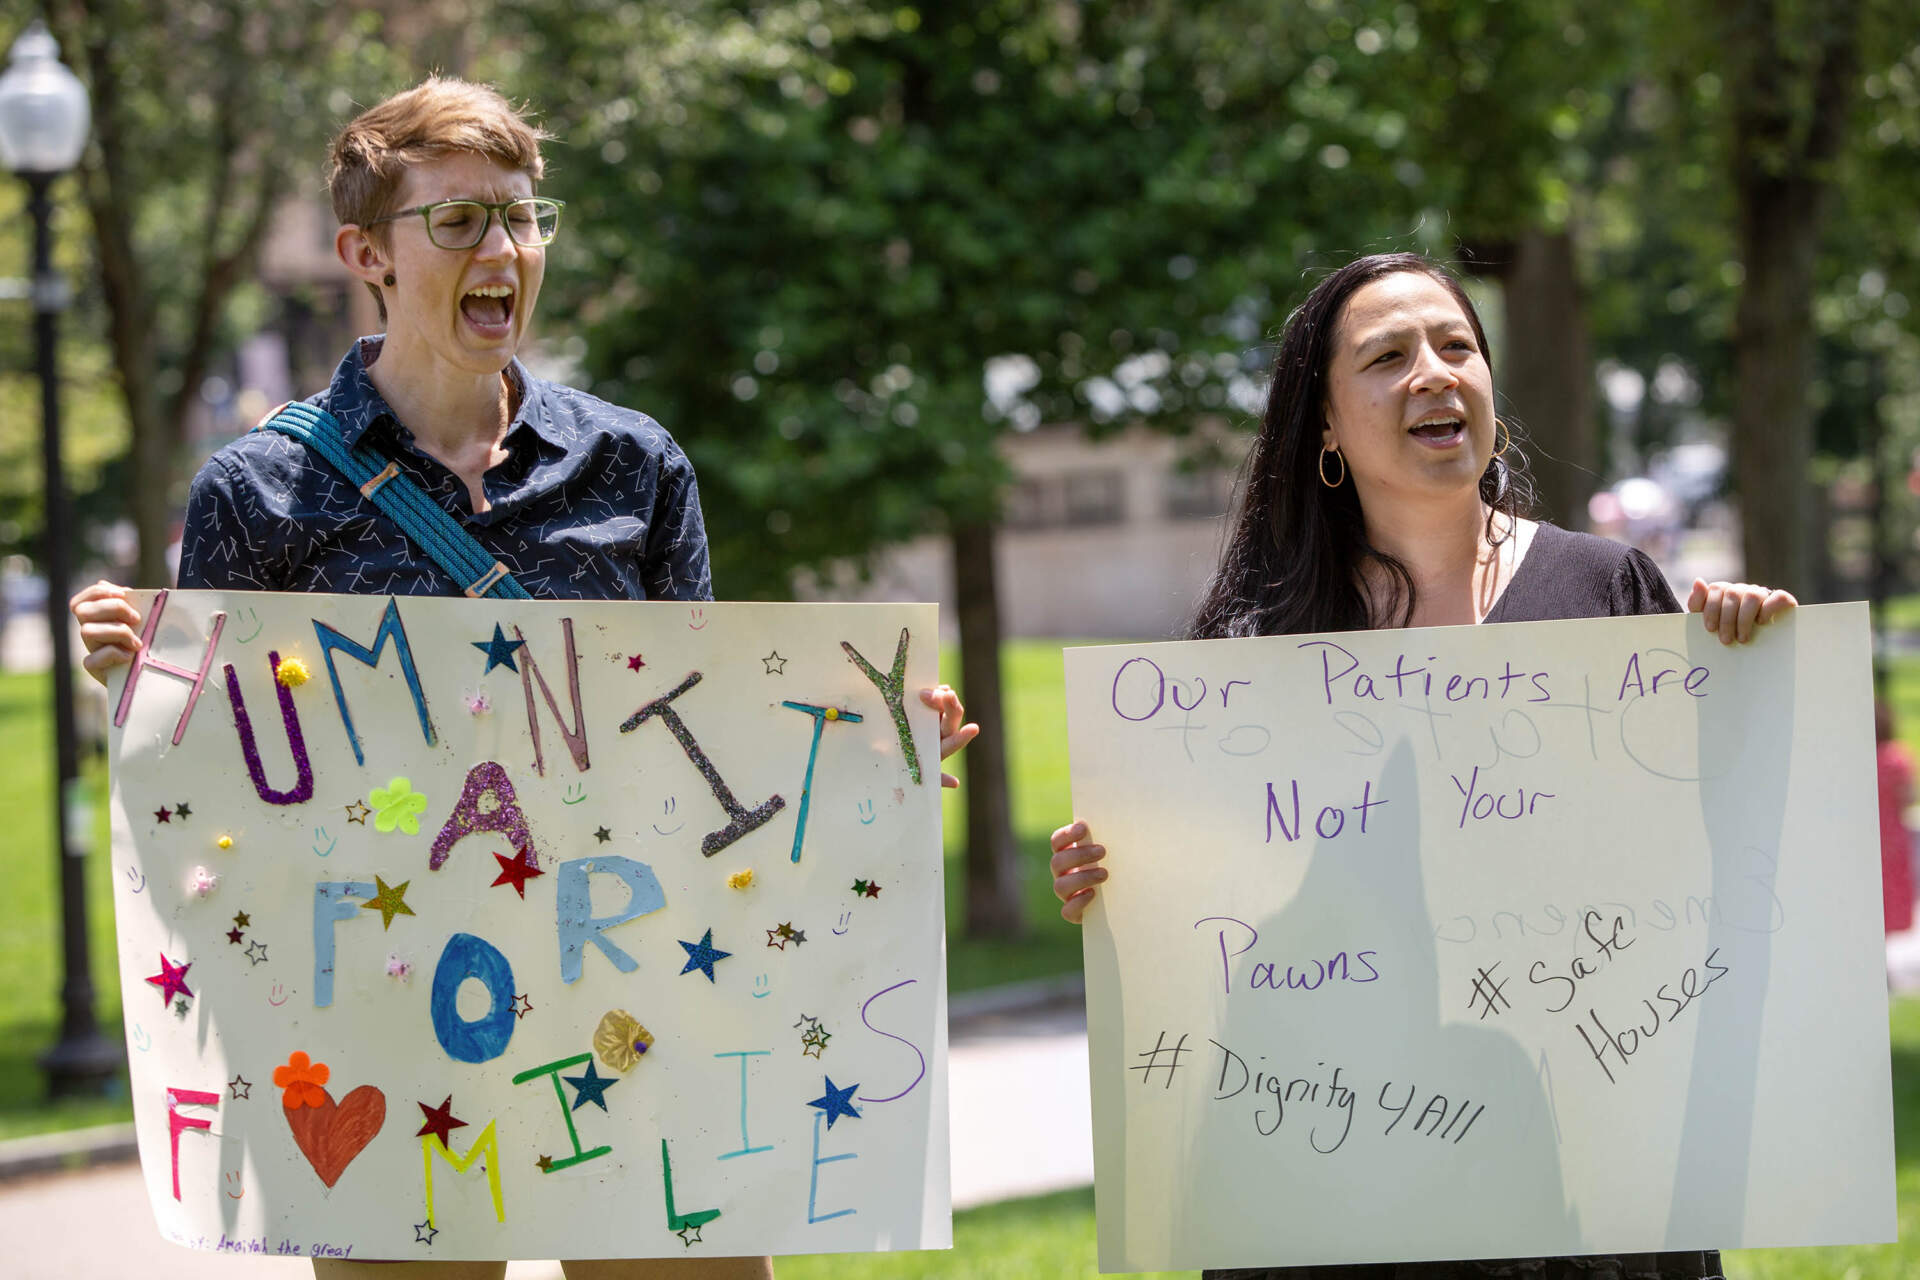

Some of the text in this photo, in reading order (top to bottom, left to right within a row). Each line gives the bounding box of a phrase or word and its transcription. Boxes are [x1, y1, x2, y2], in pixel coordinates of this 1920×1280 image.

[1112, 641, 1711, 721] Our Patients Are
[1265, 765, 1556, 843] Not Your
[313, 854, 667, 1065] FOR
[1194, 916, 1380, 994] Pawns
[1575, 947, 1730, 1084] Houses
[276, 1239, 301, 1255] the
[310, 1243, 353, 1259] great
